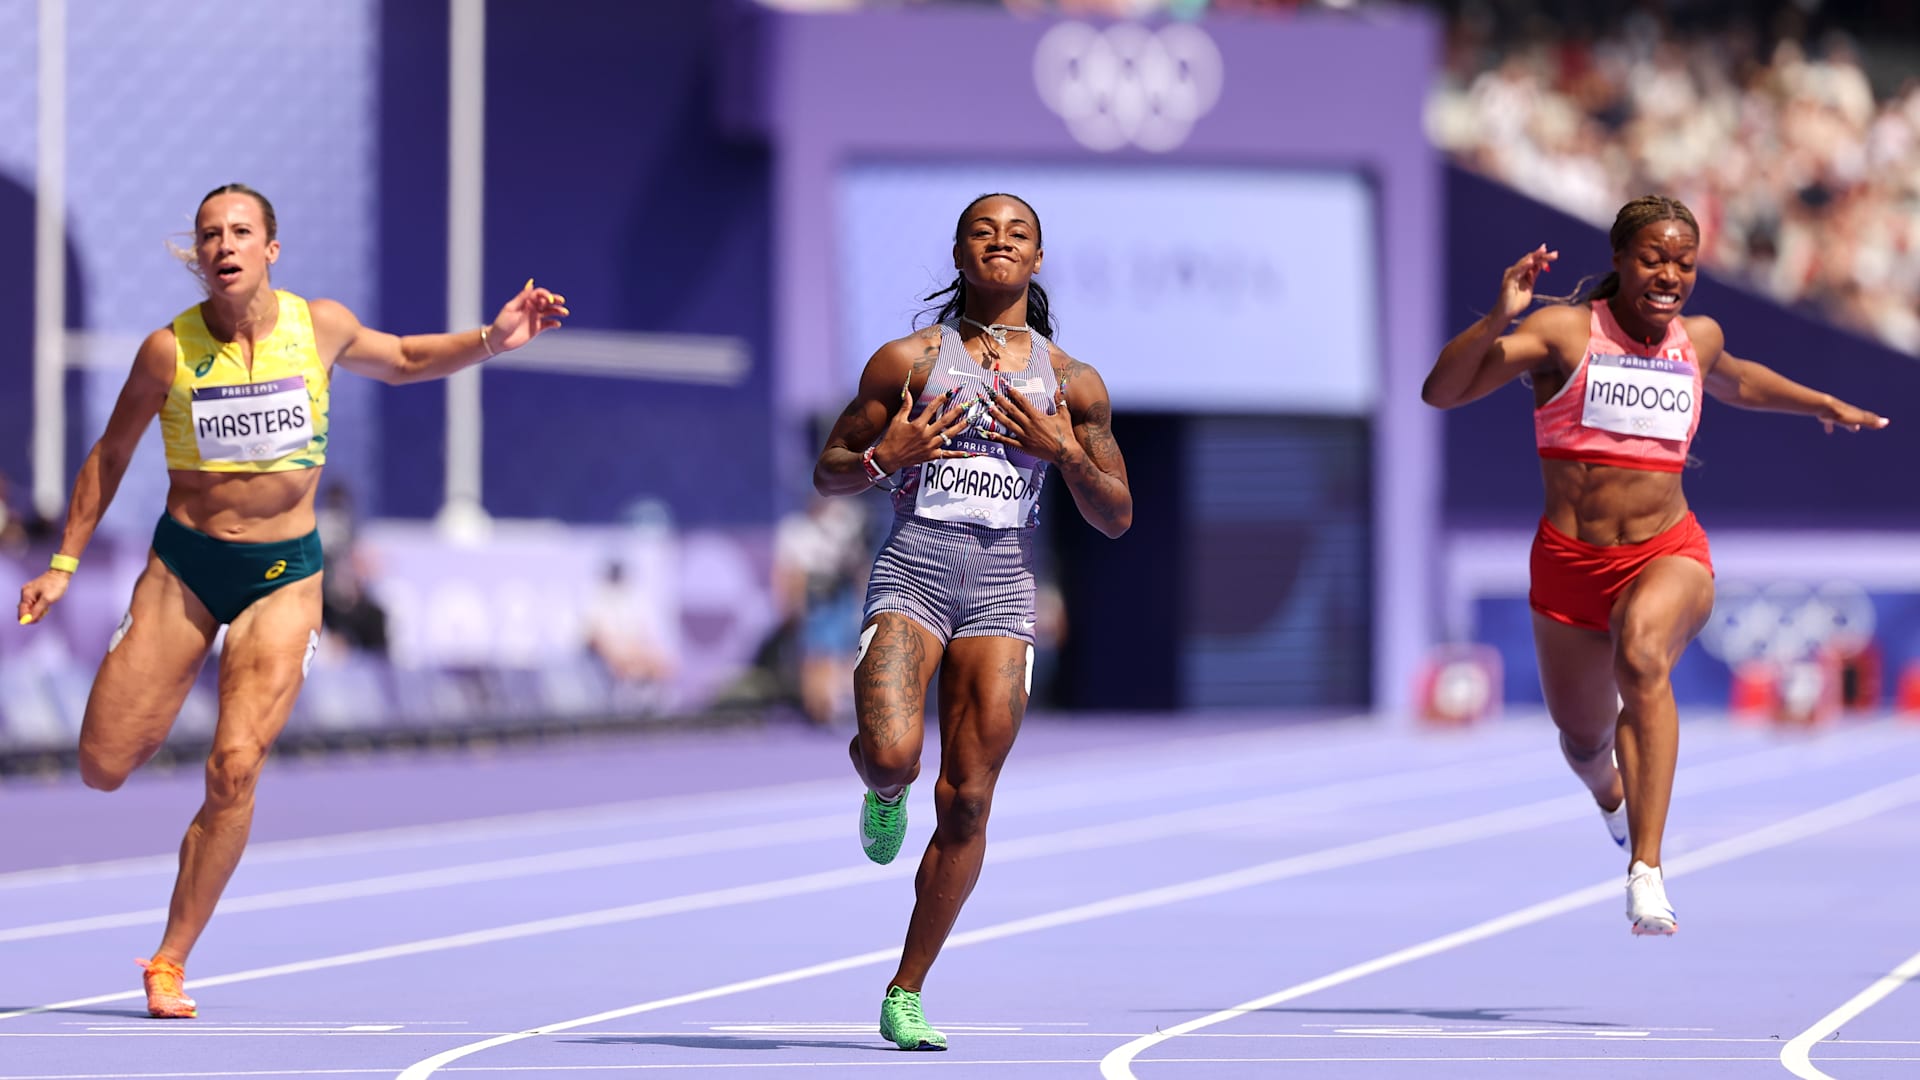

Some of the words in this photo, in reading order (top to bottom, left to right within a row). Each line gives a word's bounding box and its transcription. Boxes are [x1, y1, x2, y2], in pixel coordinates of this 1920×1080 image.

[1620, 357, 1648, 368] PARIS
[222, 386, 251, 397] PARIS
[1591, 381, 1690, 413] MADOGO
[199, 406, 305, 439] MASTERS
[956, 441, 987, 452] PARIS
[990, 446, 1004, 456] 20
[924, 463, 1035, 500] RICHARDSON
